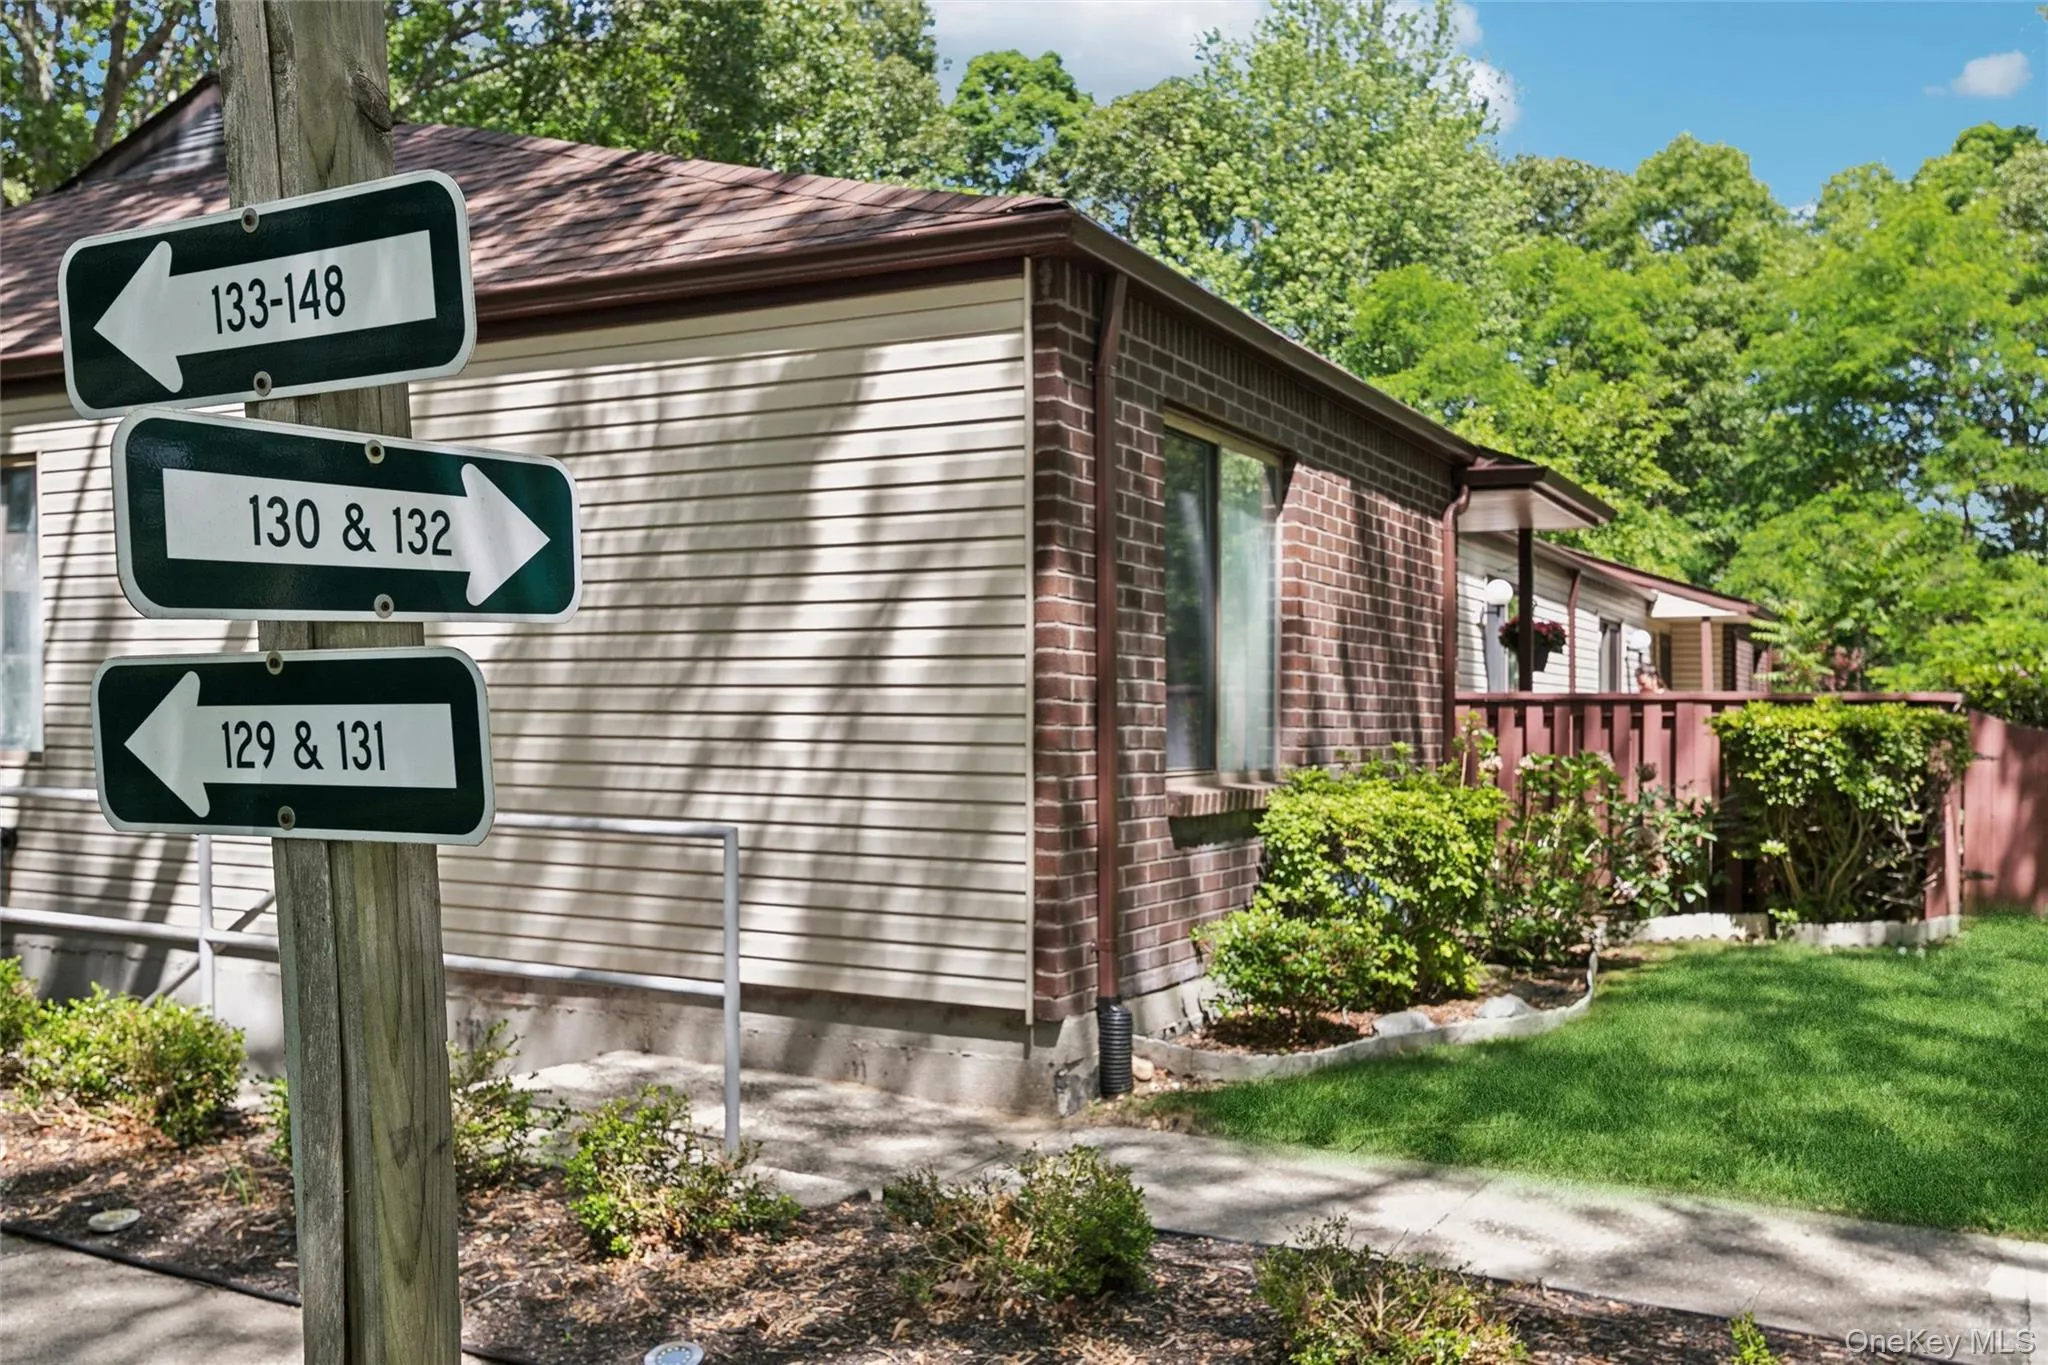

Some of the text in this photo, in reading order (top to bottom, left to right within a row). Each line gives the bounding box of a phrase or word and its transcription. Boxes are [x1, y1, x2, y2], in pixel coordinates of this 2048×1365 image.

[211, 265, 346, 335] 133-148
[249, 494, 453, 557] 130 & 132
[221, 720, 386, 772] 129 & 131
